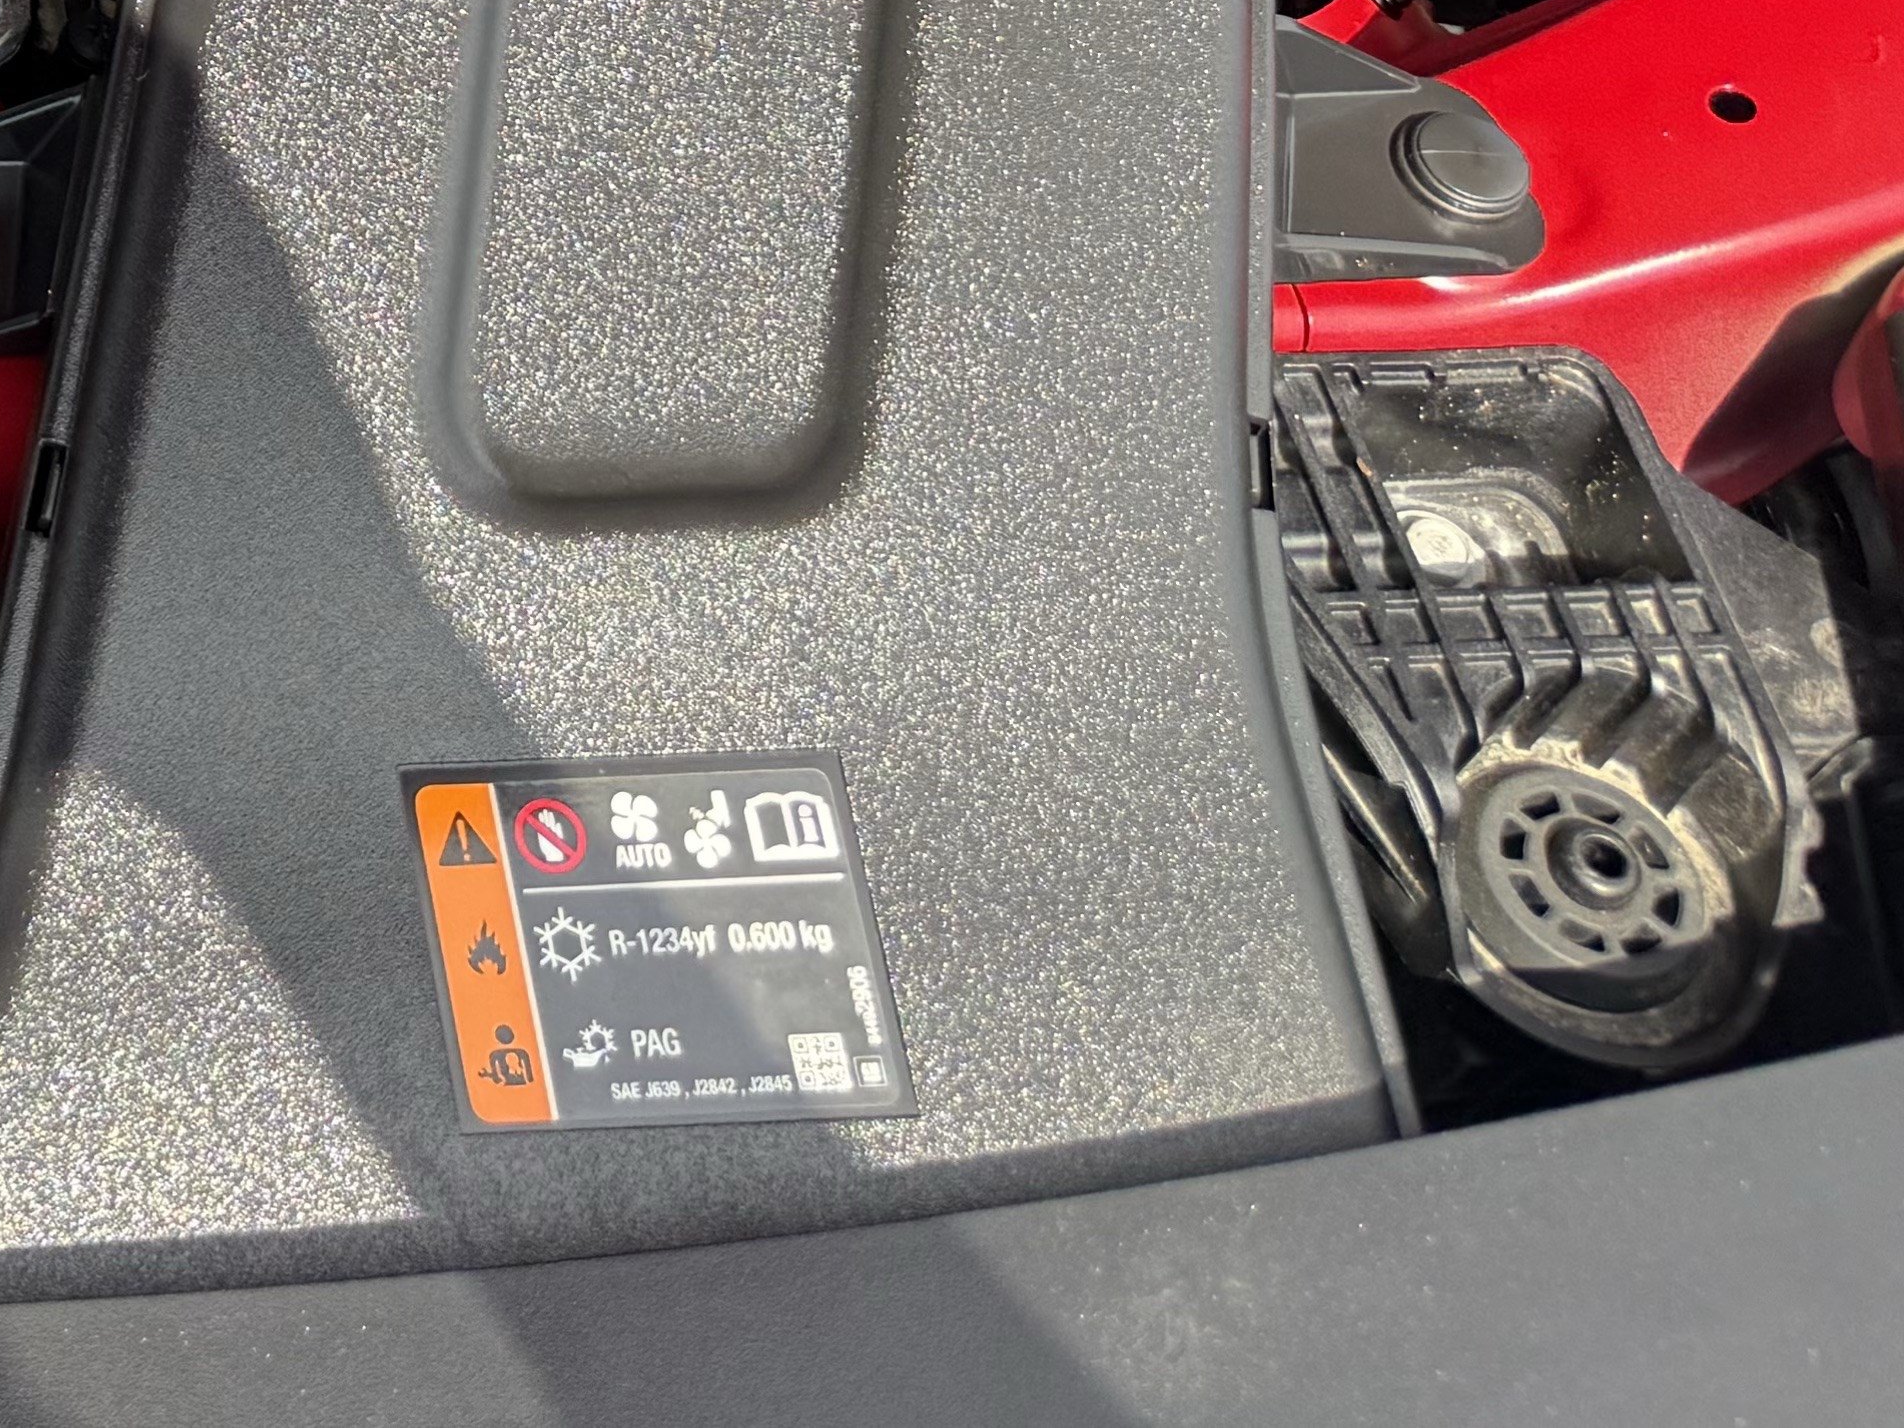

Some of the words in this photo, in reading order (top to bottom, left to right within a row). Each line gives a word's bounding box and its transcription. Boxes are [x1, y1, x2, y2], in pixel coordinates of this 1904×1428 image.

[615, 842, 672, 869] AUTO
[608, 924, 717, 959] R-1234yf
[727, 920, 797, 954] 0.600
[798, 919, 835, 955] kg
[630, 1027, 682, 1058] PAG
[610, 1081, 640, 1100] SAE
[748, 1074, 793, 1092] J2845
